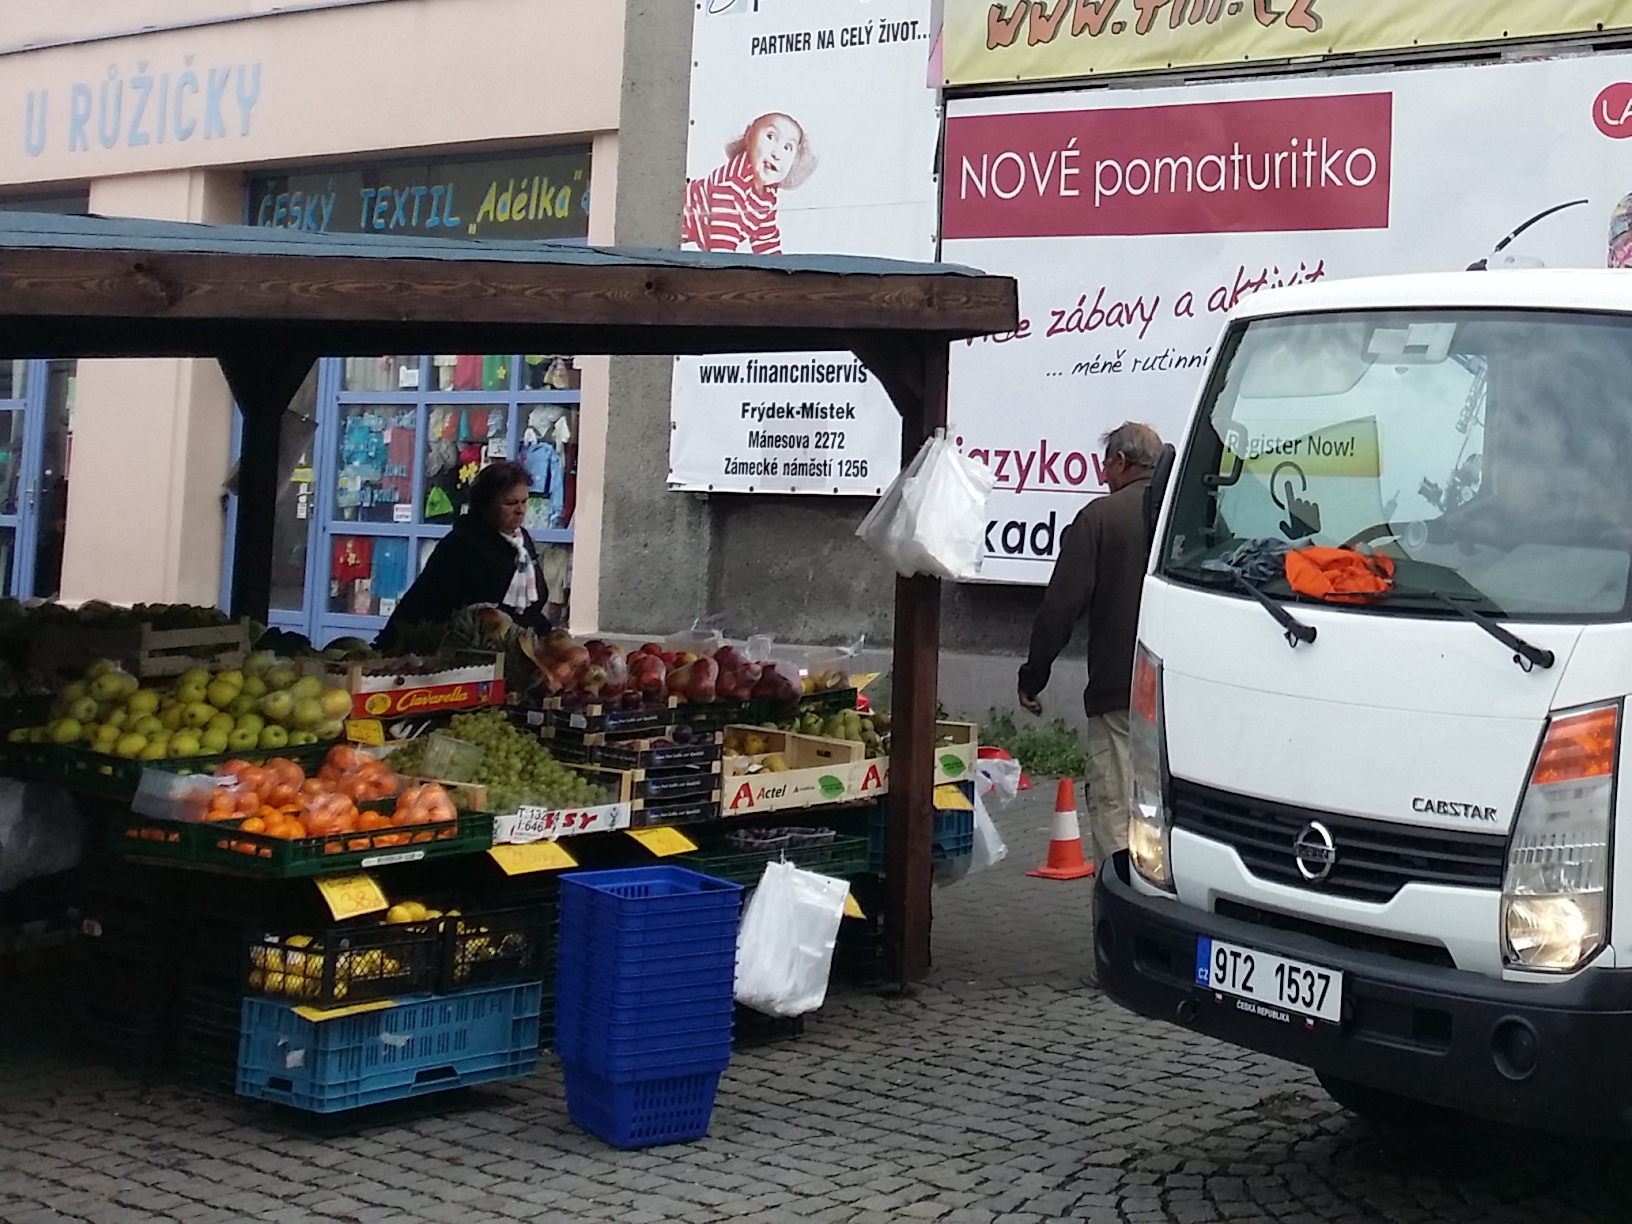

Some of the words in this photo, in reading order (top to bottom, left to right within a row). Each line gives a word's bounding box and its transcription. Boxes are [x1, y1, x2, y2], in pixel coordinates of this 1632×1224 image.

[750, 31, 812, 56] PARTNER
[816, 30, 836, 51] NA
[840, 19, 874, 47] CELÝ
[23, 89, 49, 158] U
[67, 52, 263, 154] RŮŽIČKY
[960, 136, 1081, 201] NOVÉ
[1093, 137, 1378, 208] pomaturitko
[359, 182, 461, 231] TEXTIL
[1045, 286, 1160, 340] zábavy
[1173, 291, 1194, 320] a
[1070, 349, 1123, 377] méně
[740, 402, 857, 423] Frýdek-Místek
[747, 429, 811, 450] Mánesova
[814, 431, 846, 450] 2272
[1307, 435, 1355, 457] Now!
[723, 456, 779, 476] Zámecké
[782, 457, 833, 477] náměstí
[837, 459, 869, 478] 1256
[756, 784, 788, 801] Actel
[1412, 797, 1498, 822] CABSTAR
[1214, 947, 1256, 994] 9T2
[1275, 963, 1331, 1012] 1537
